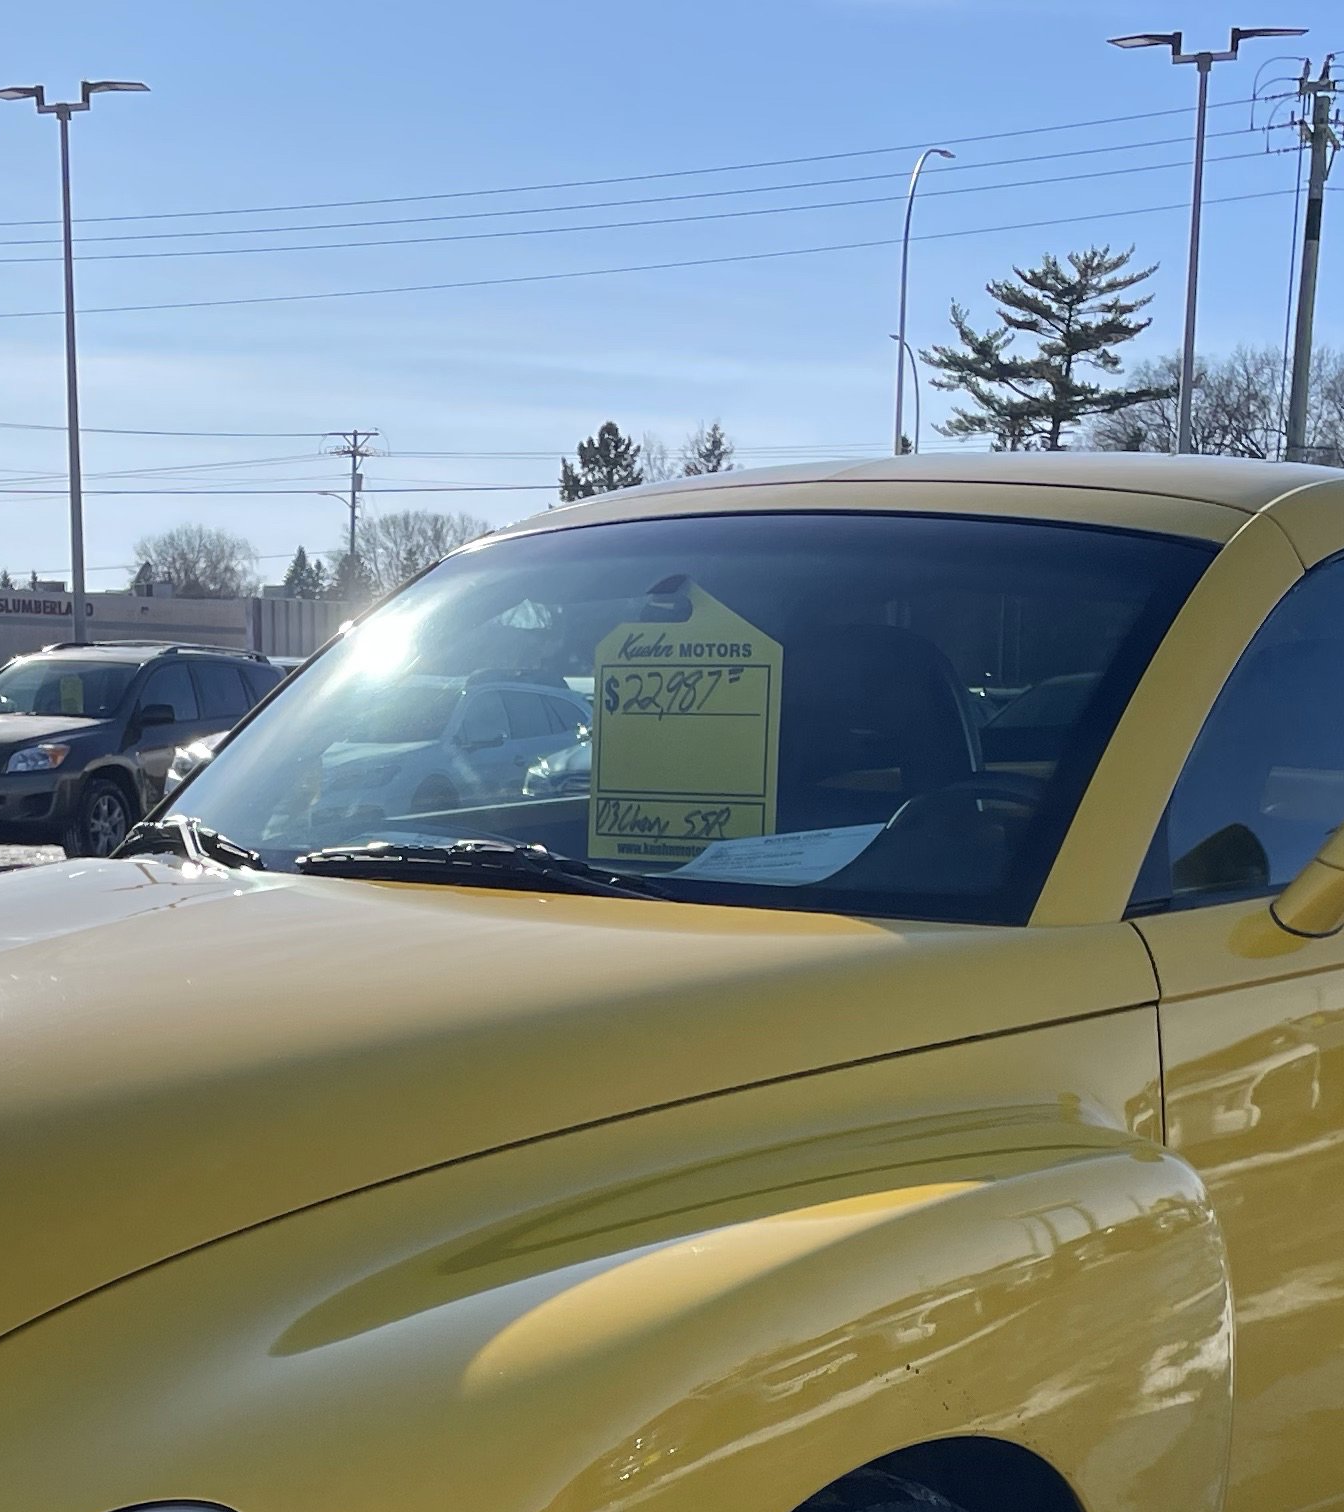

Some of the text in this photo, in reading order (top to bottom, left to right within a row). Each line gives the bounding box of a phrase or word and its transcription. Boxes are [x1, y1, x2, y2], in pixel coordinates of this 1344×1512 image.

[618, 632, 753, 661] Kuehn MOTORS
[683, 806, 732, 839] SSR
